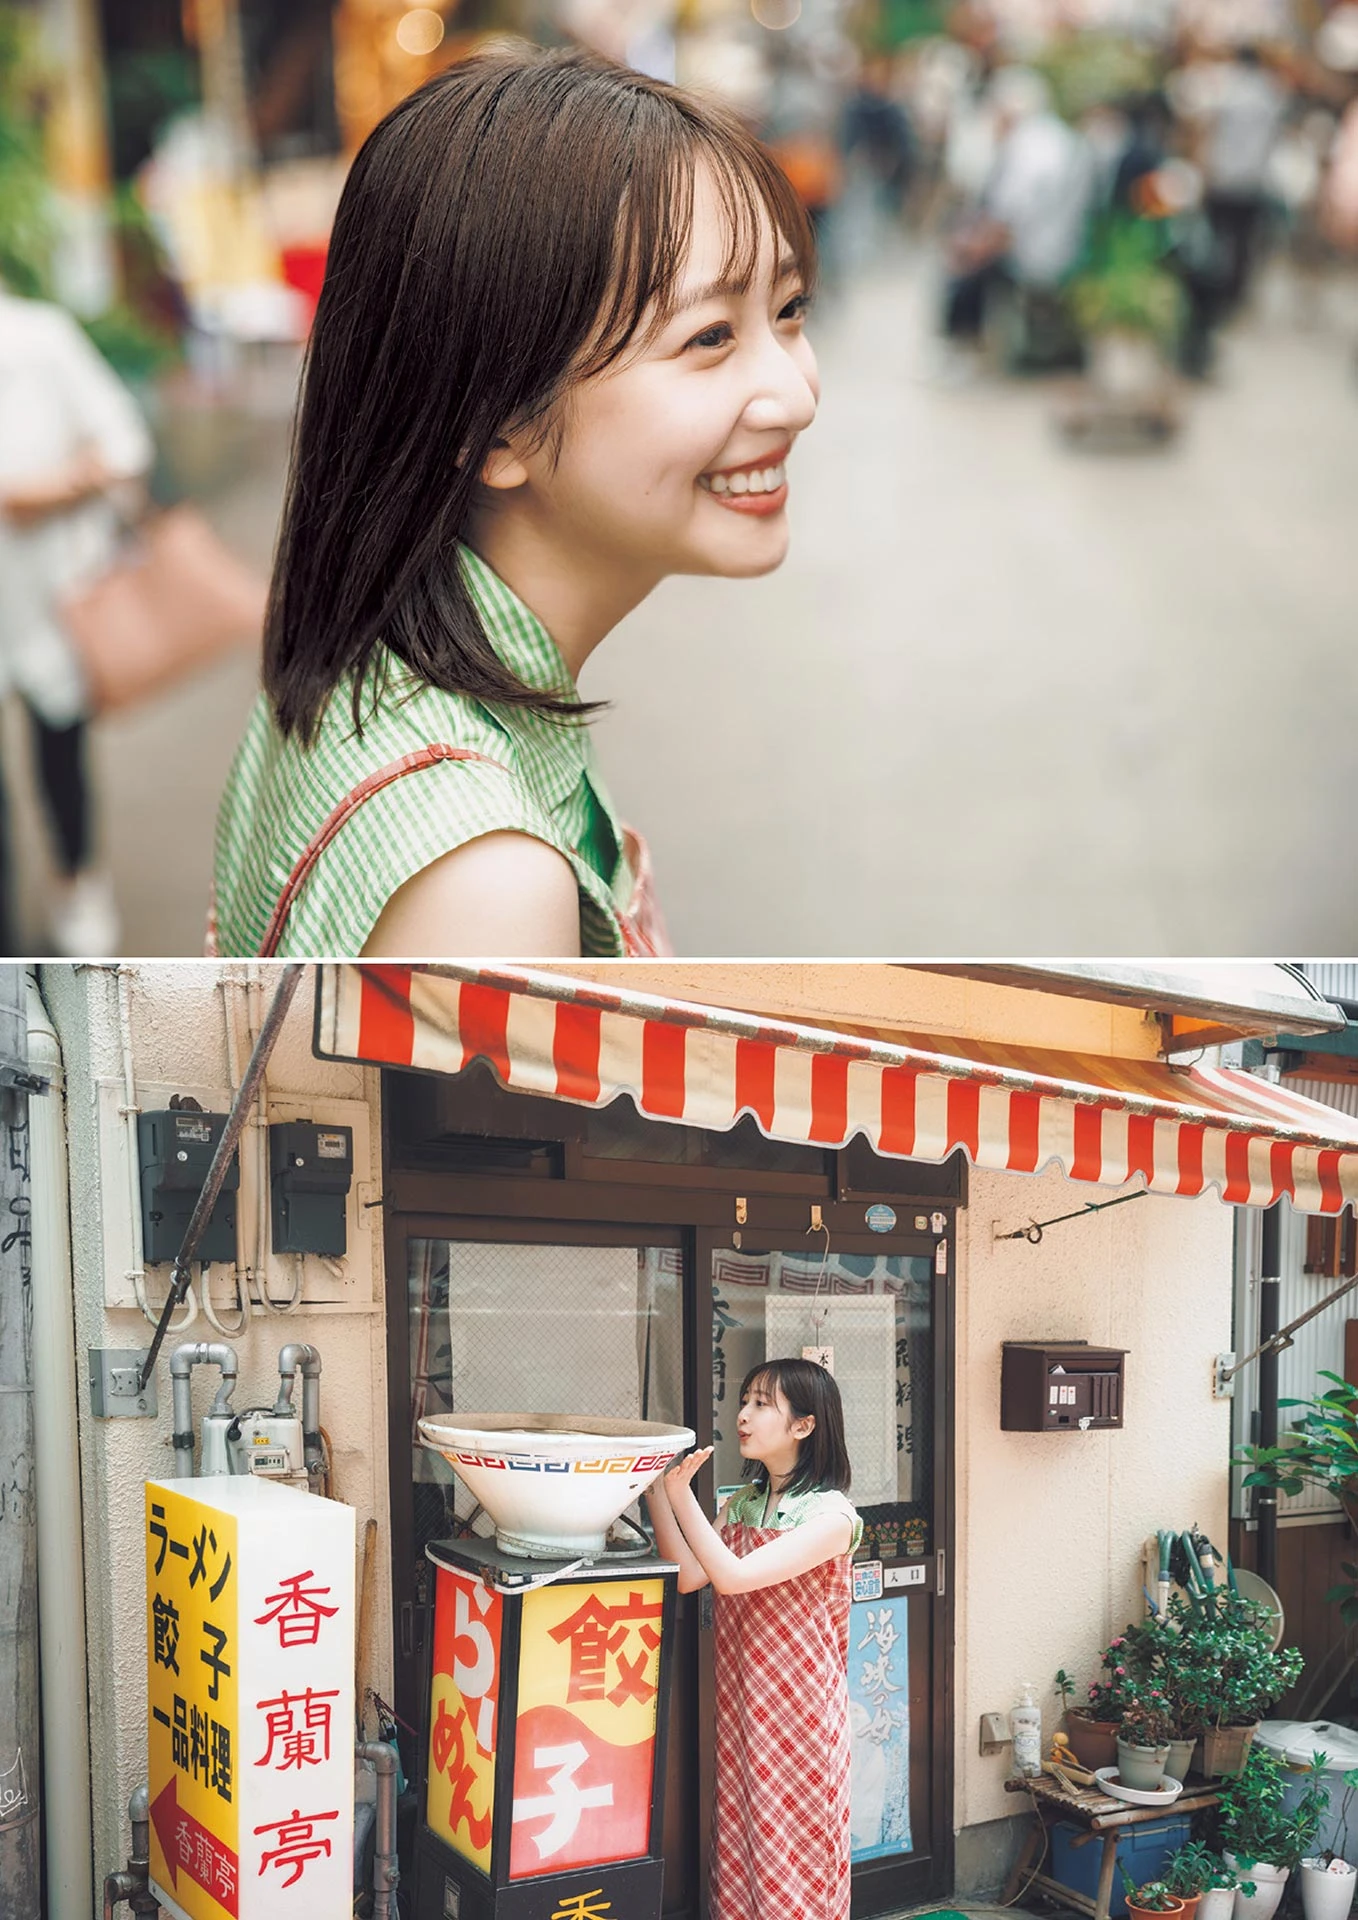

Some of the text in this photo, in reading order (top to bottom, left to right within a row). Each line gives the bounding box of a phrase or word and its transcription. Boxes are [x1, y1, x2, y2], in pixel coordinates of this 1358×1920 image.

[149, 1503, 232, 1602] ラーメン
[890, 1569, 919, 1582] 入口
[152, 1594, 231, 1702] 餃子
[153, 1696, 232, 1804] 一品料理
[253, 1570, 340, 1889] 香蘭亭
[511, 1592, 662, 1859] 餃子
[175, 1821, 236, 1899] 香蘭亭
